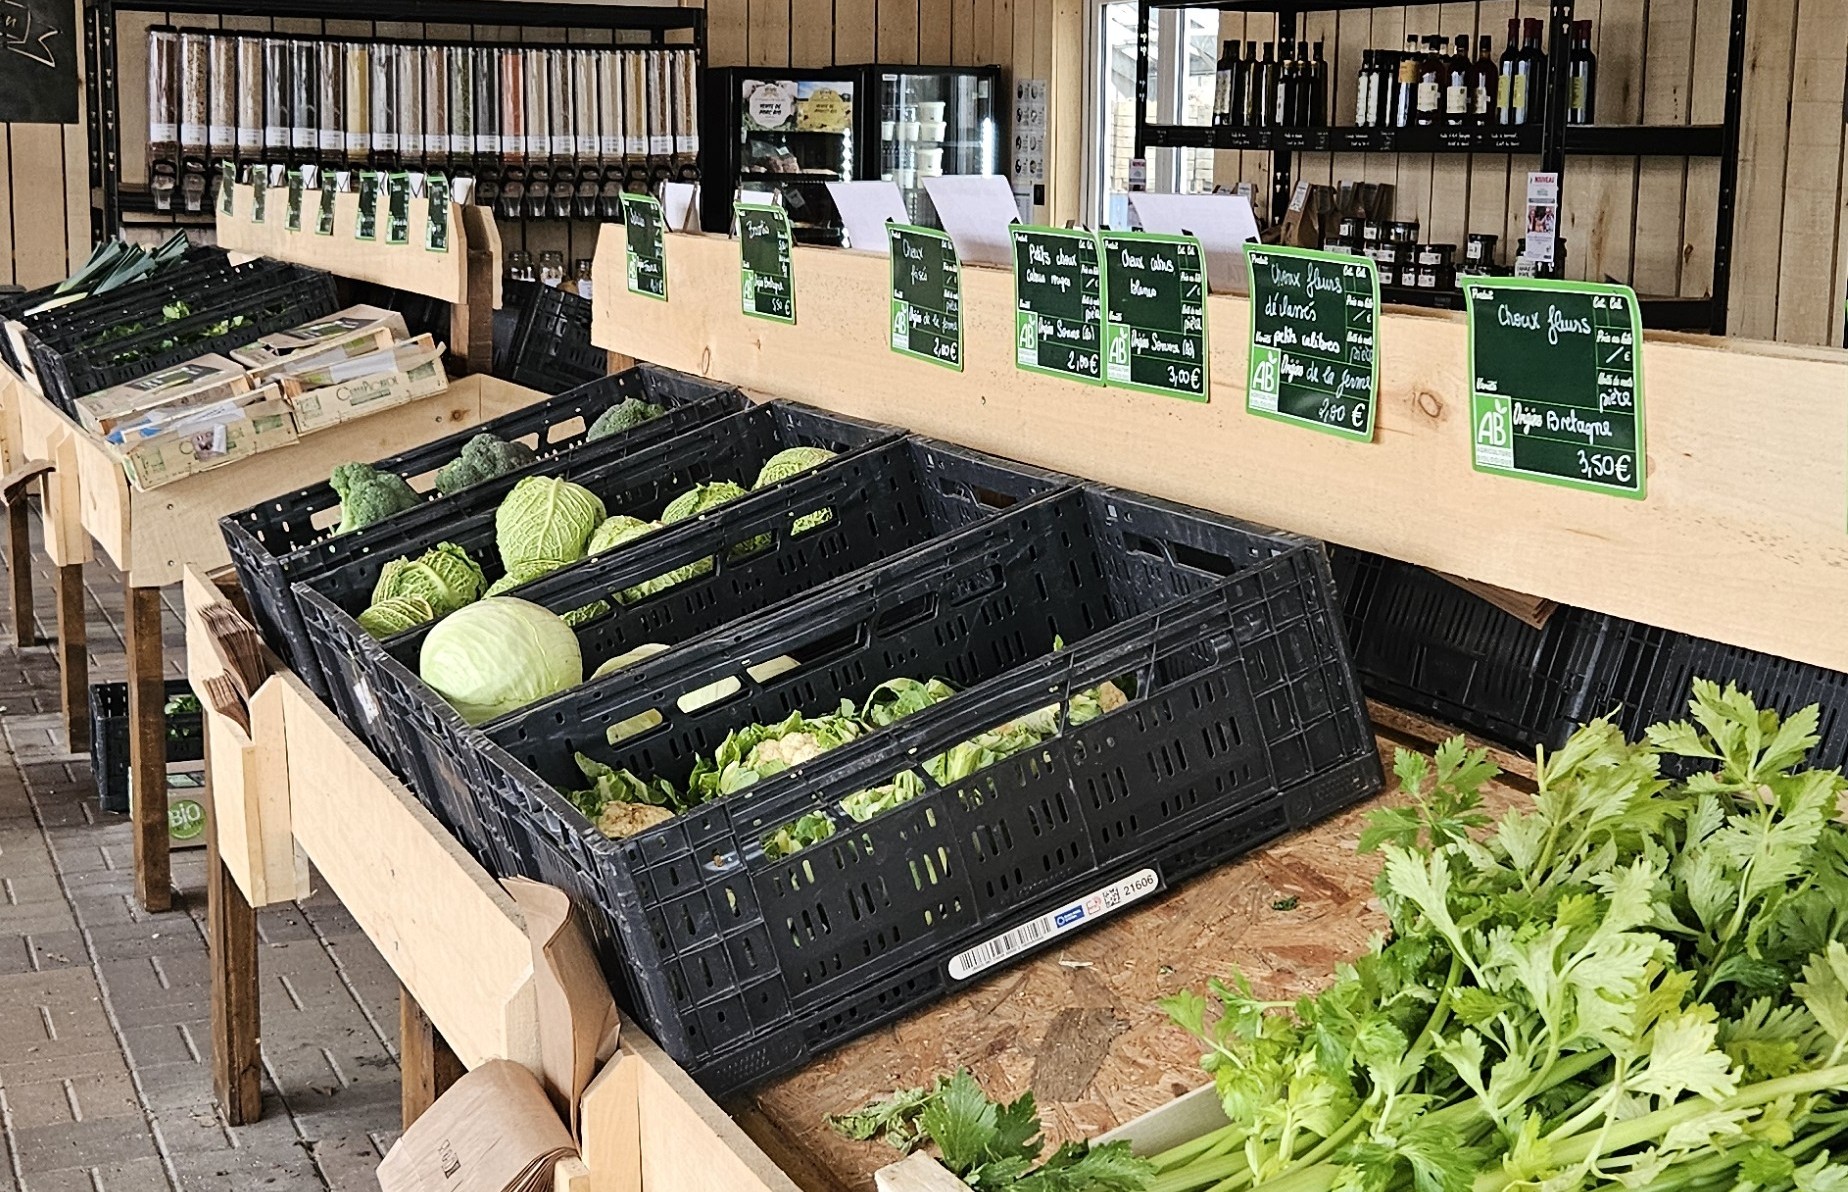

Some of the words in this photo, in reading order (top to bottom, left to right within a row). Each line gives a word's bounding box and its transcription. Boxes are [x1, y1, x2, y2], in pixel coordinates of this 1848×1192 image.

[1270, 262, 1301, 287] Choux
[1306, 261, 1343, 299] fleurs
[1020, 323, 1035, 349] AB
[1497, 303, 1541, 331] Choux
[1547, 305, 1592, 345] fleurs
[1109, 336, 1127, 364] AB
[1252, 360, 1275, 392] AB
[1306, 360, 1319, 383] de
[1322, 365, 1336, 386] la
[1335, 368, 1372, 399] ferme
[1477, 410, 1508, 447] AB
[1512, 402, 1543, 435] Origine
[1546, 409, 1613, 446] Bretagne
[1576, 449, 1632, 483] 3,50€
[1123, 874, 1154, 896] 21606
